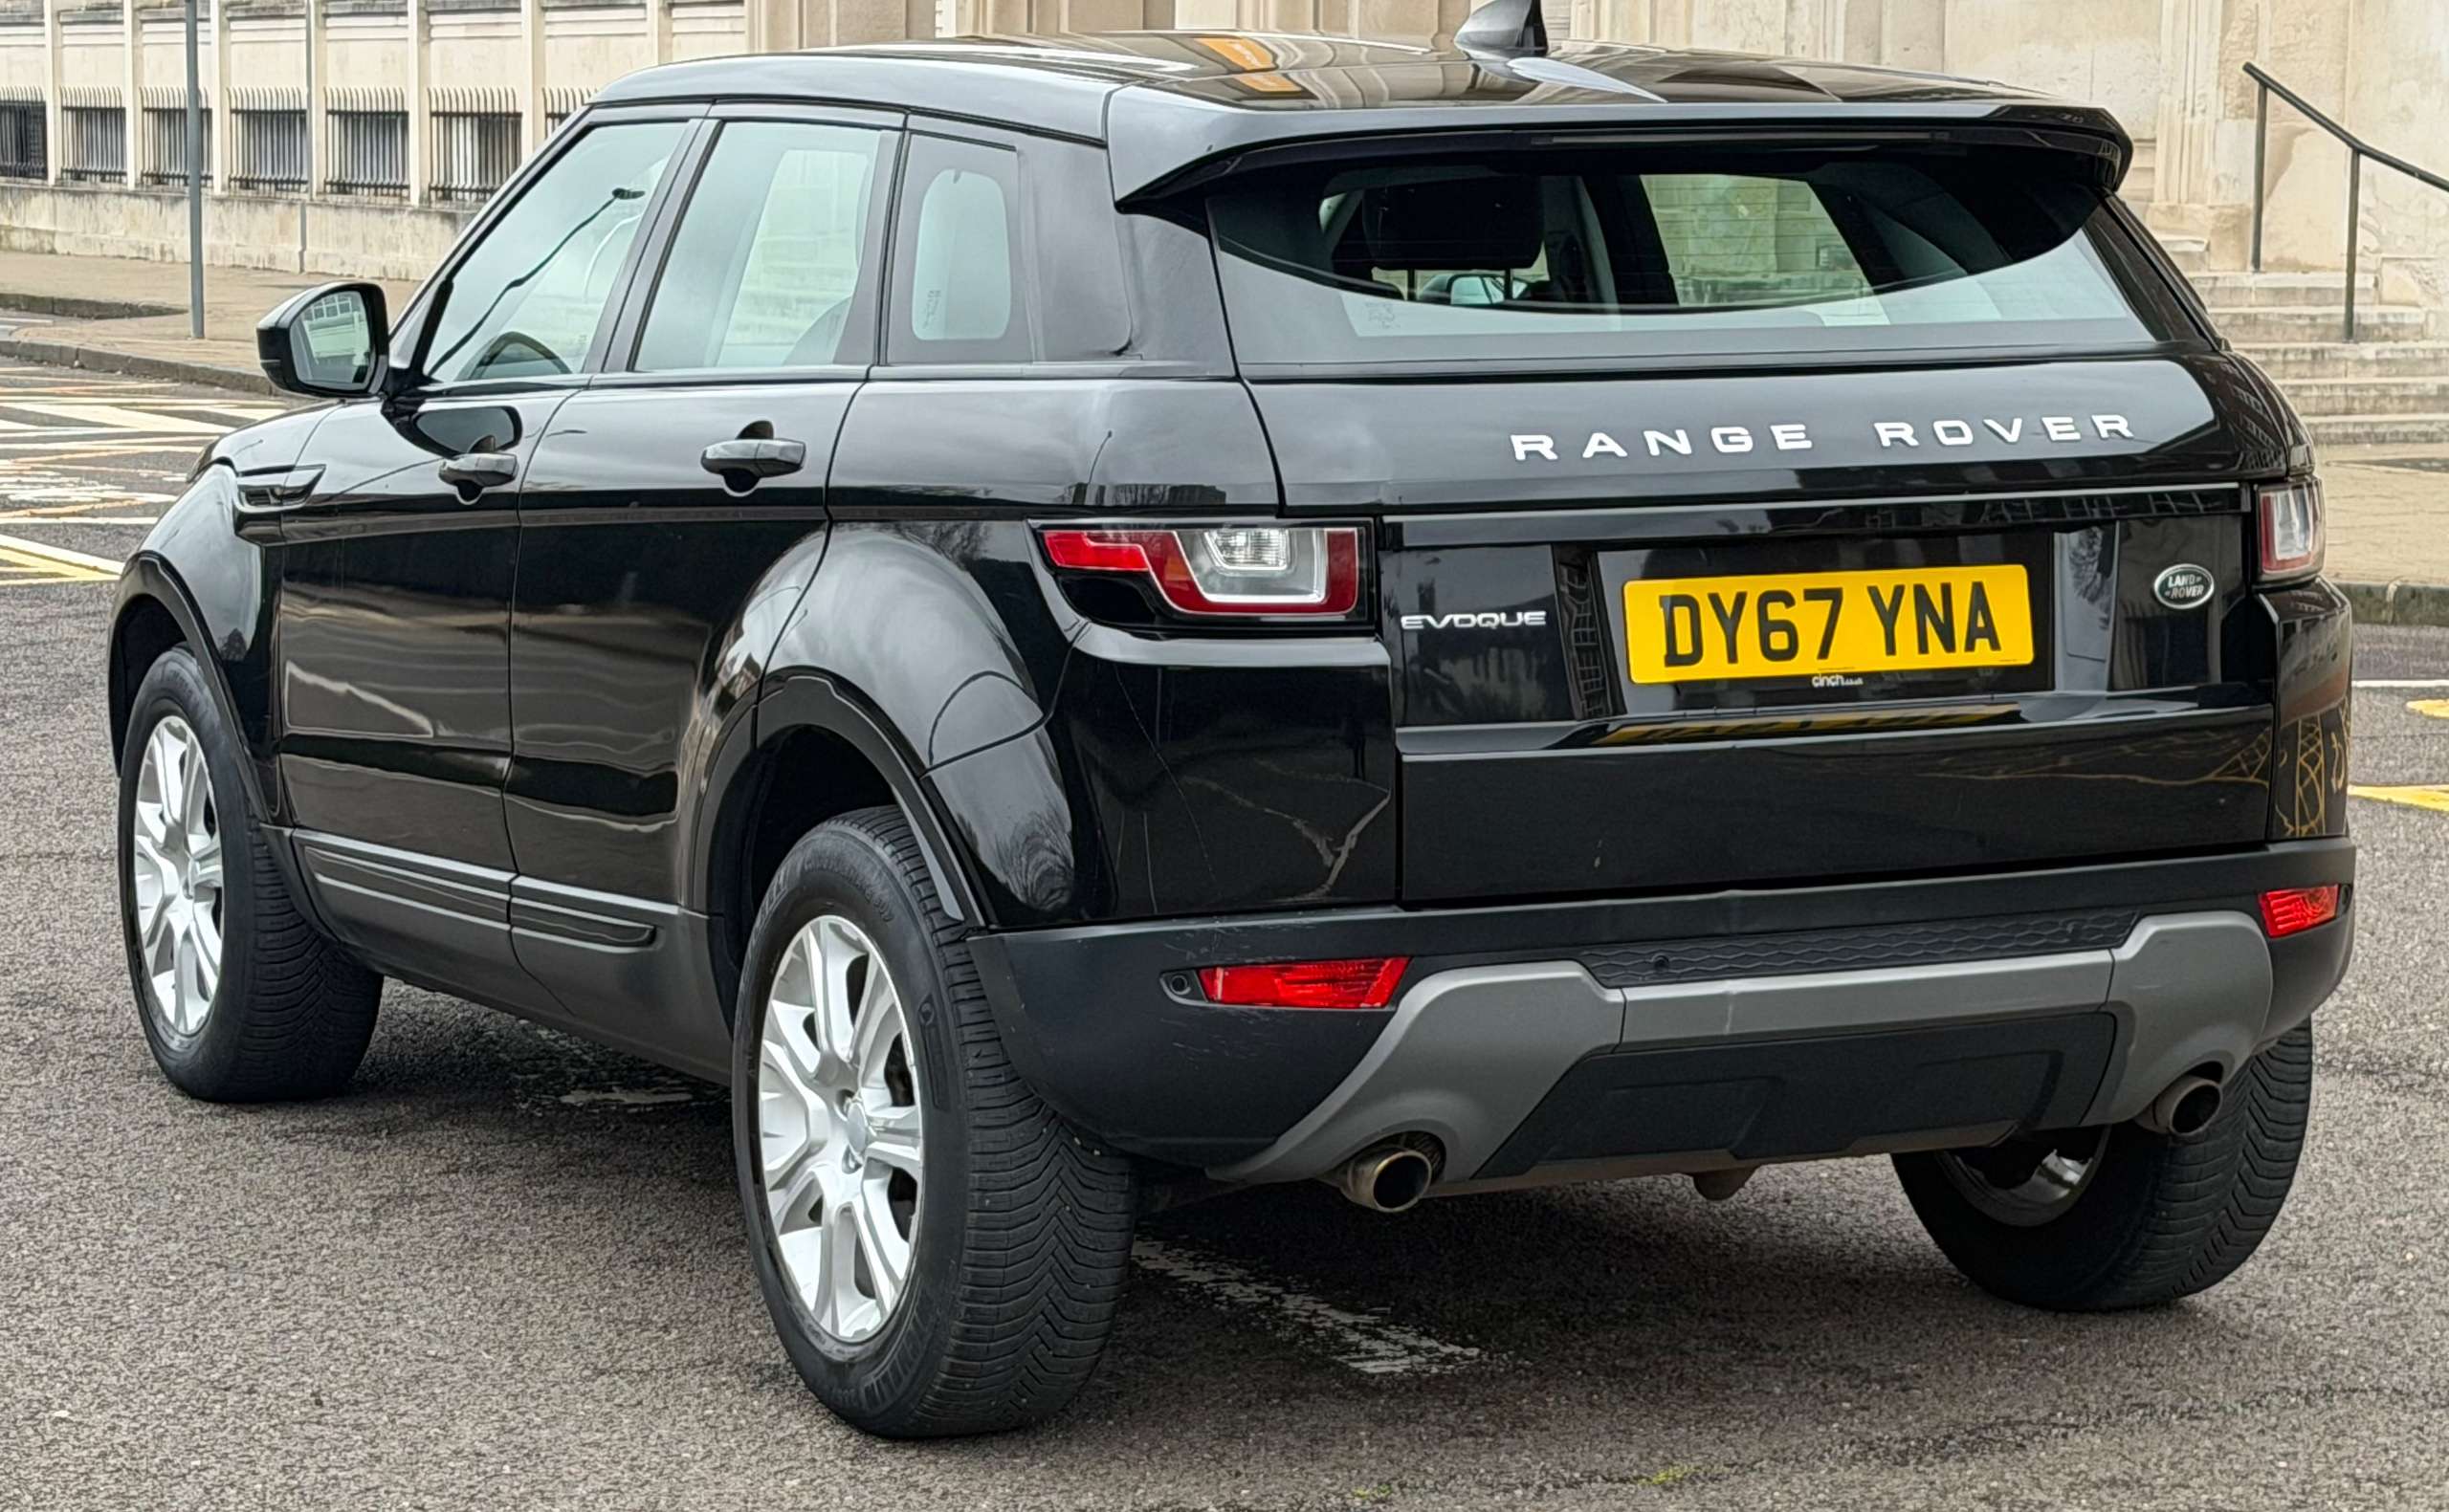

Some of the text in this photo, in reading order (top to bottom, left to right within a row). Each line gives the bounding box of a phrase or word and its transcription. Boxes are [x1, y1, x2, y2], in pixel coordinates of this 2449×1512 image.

[1510, 414, 2134, 461] RANGE ROVER
[2168, 574, 2196, 588] LAND
[2170, 584, 2204, 599] ROVER
[1401, 611, 1546, 629] EVOQUE
[1659, 581, 2001, 668] DY67 YNA
